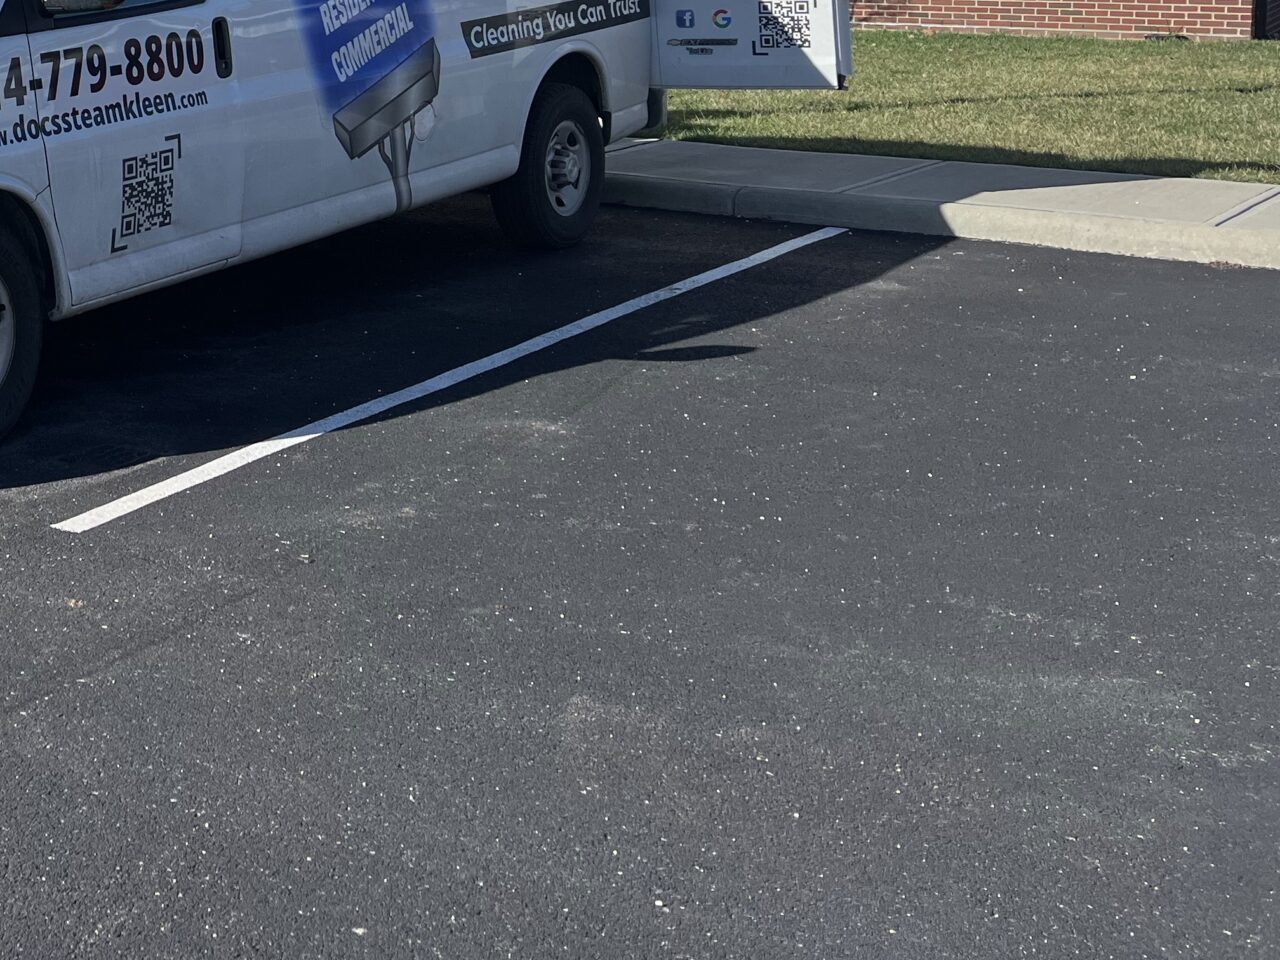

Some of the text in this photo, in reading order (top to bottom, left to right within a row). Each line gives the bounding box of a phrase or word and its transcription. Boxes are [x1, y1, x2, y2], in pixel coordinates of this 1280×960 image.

[331, 2, 415, 83] COMMERCIAL
[470, 14, 544, 49] Cleaning
[547, 10, 575, 33] You
[577, 3, 606, 26] Can
